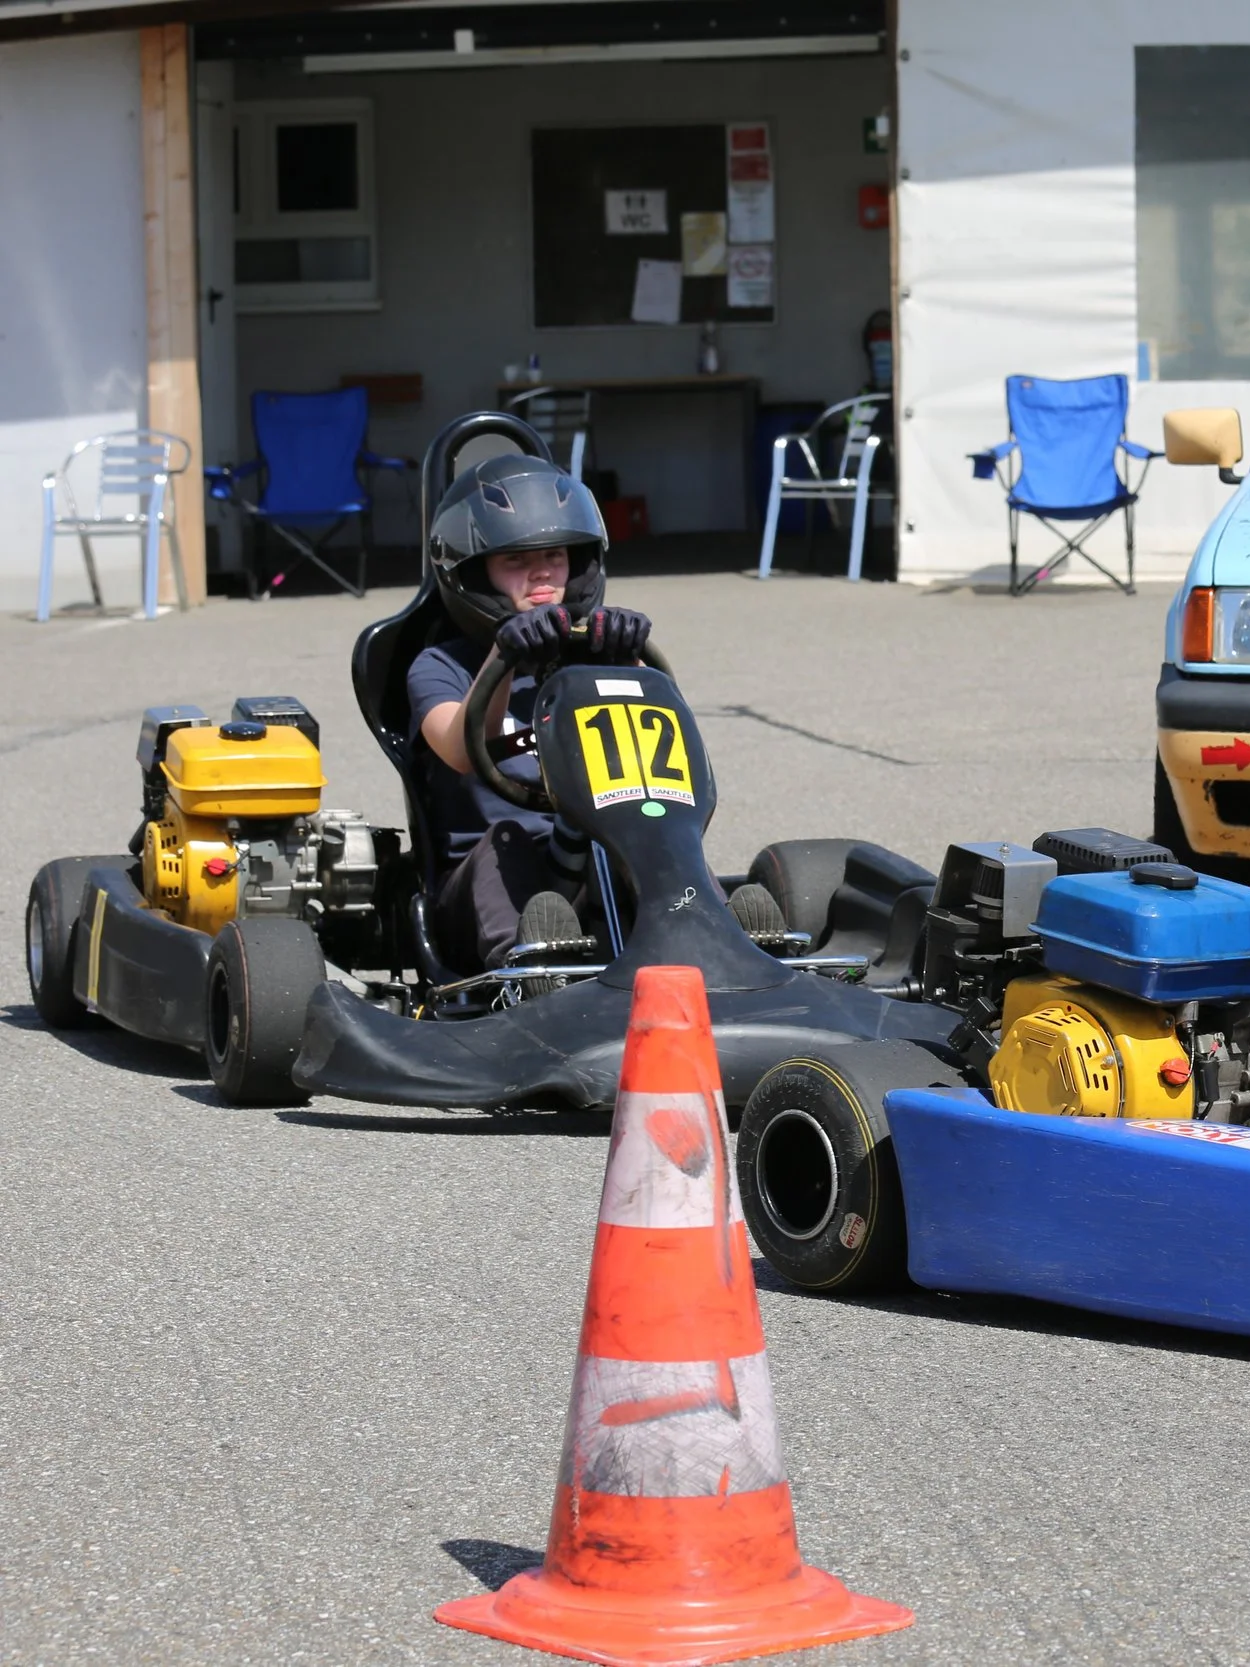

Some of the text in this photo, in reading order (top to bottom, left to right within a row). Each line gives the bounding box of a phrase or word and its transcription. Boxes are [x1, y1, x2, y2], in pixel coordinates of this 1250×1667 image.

[620, 213, 652, 229] WC
[585, 708, 683, 781] 12
[596, 788, 642, 802] SANDTLER
[651, 788, 692, 800] SANDTLER
